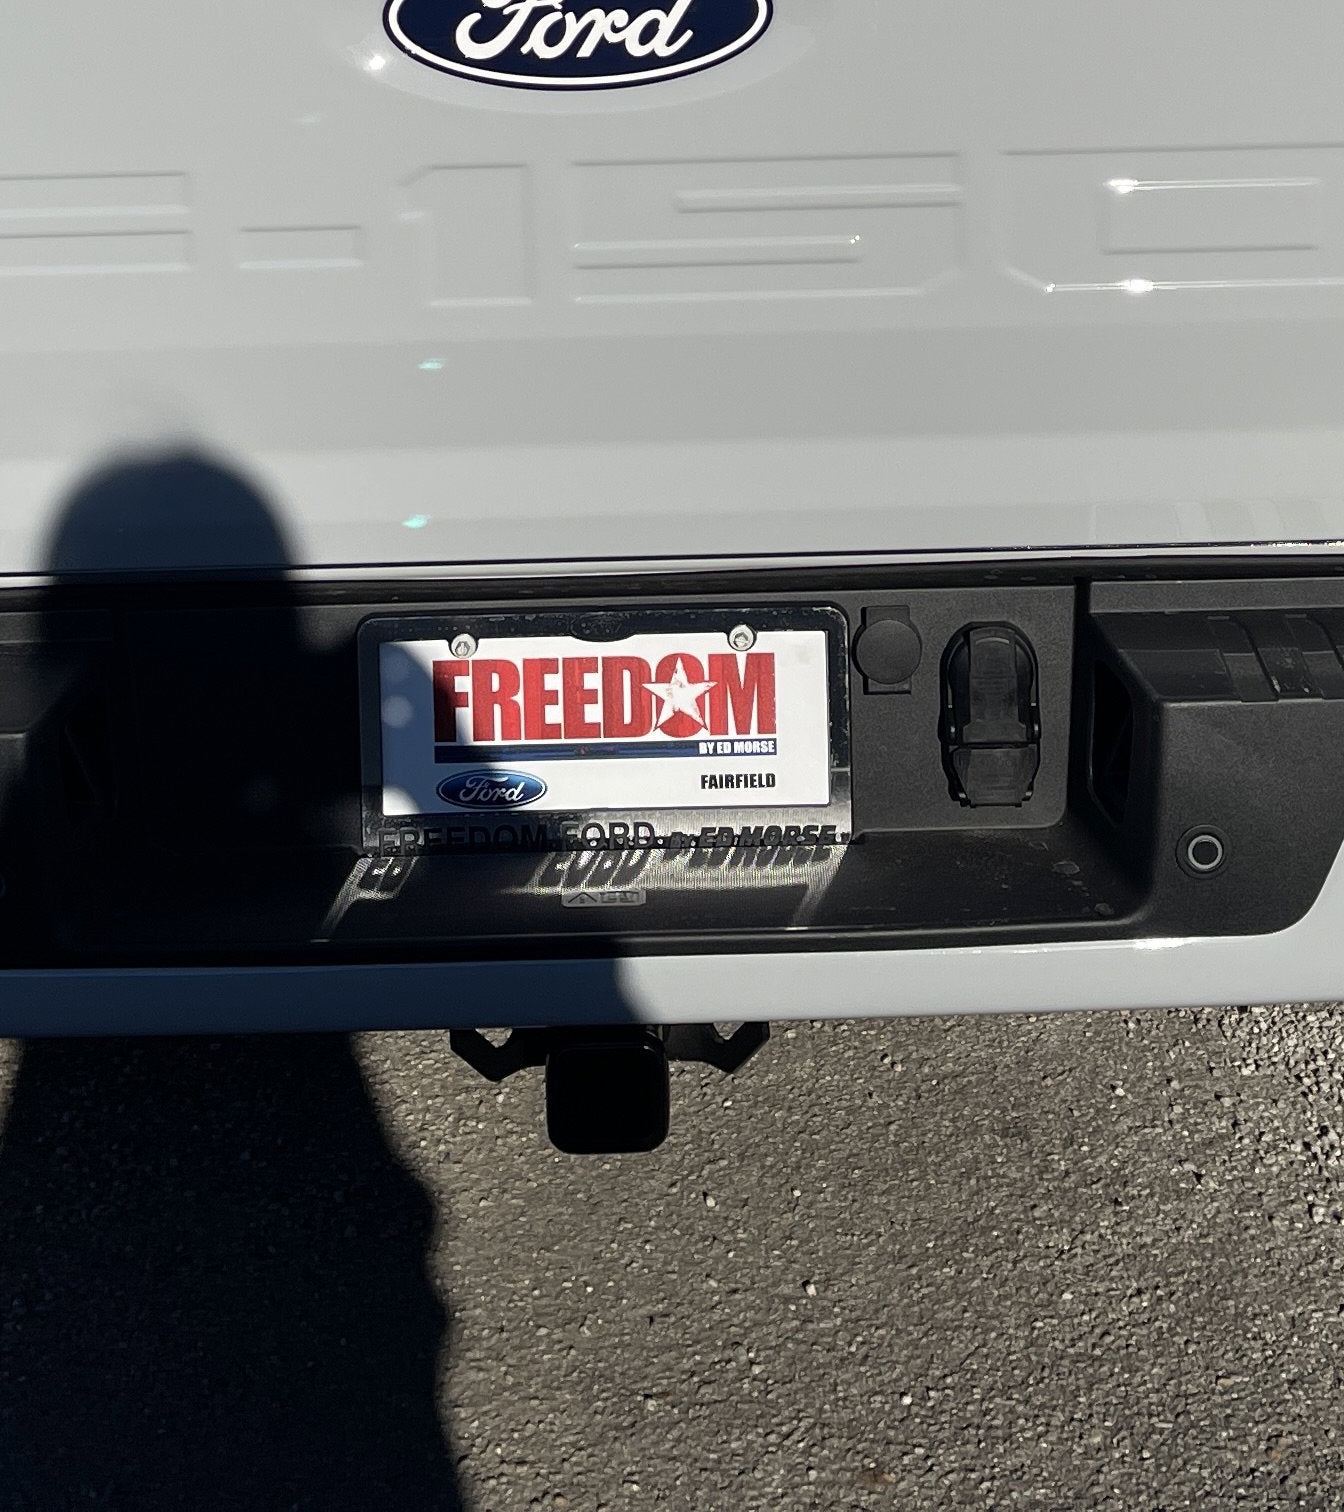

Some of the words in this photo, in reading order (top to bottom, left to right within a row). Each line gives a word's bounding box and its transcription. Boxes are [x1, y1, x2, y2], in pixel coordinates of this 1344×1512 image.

[432, 652, 777, 743] FREEDOM
[699, 742, 714, 754] BY
[717, 741, 731, 754] ED
[734, 740, 775, 753] MORSE
[459, 775, 525, 801] Ford
[700, 773, 776, 789] FAIRFIELD
[377, 823, 548, 857] FREEDOM
[560, 822, 656, 851] FORD
[699, 827, 735, 847] ED
[738, 825, 837, 847] MORSE
